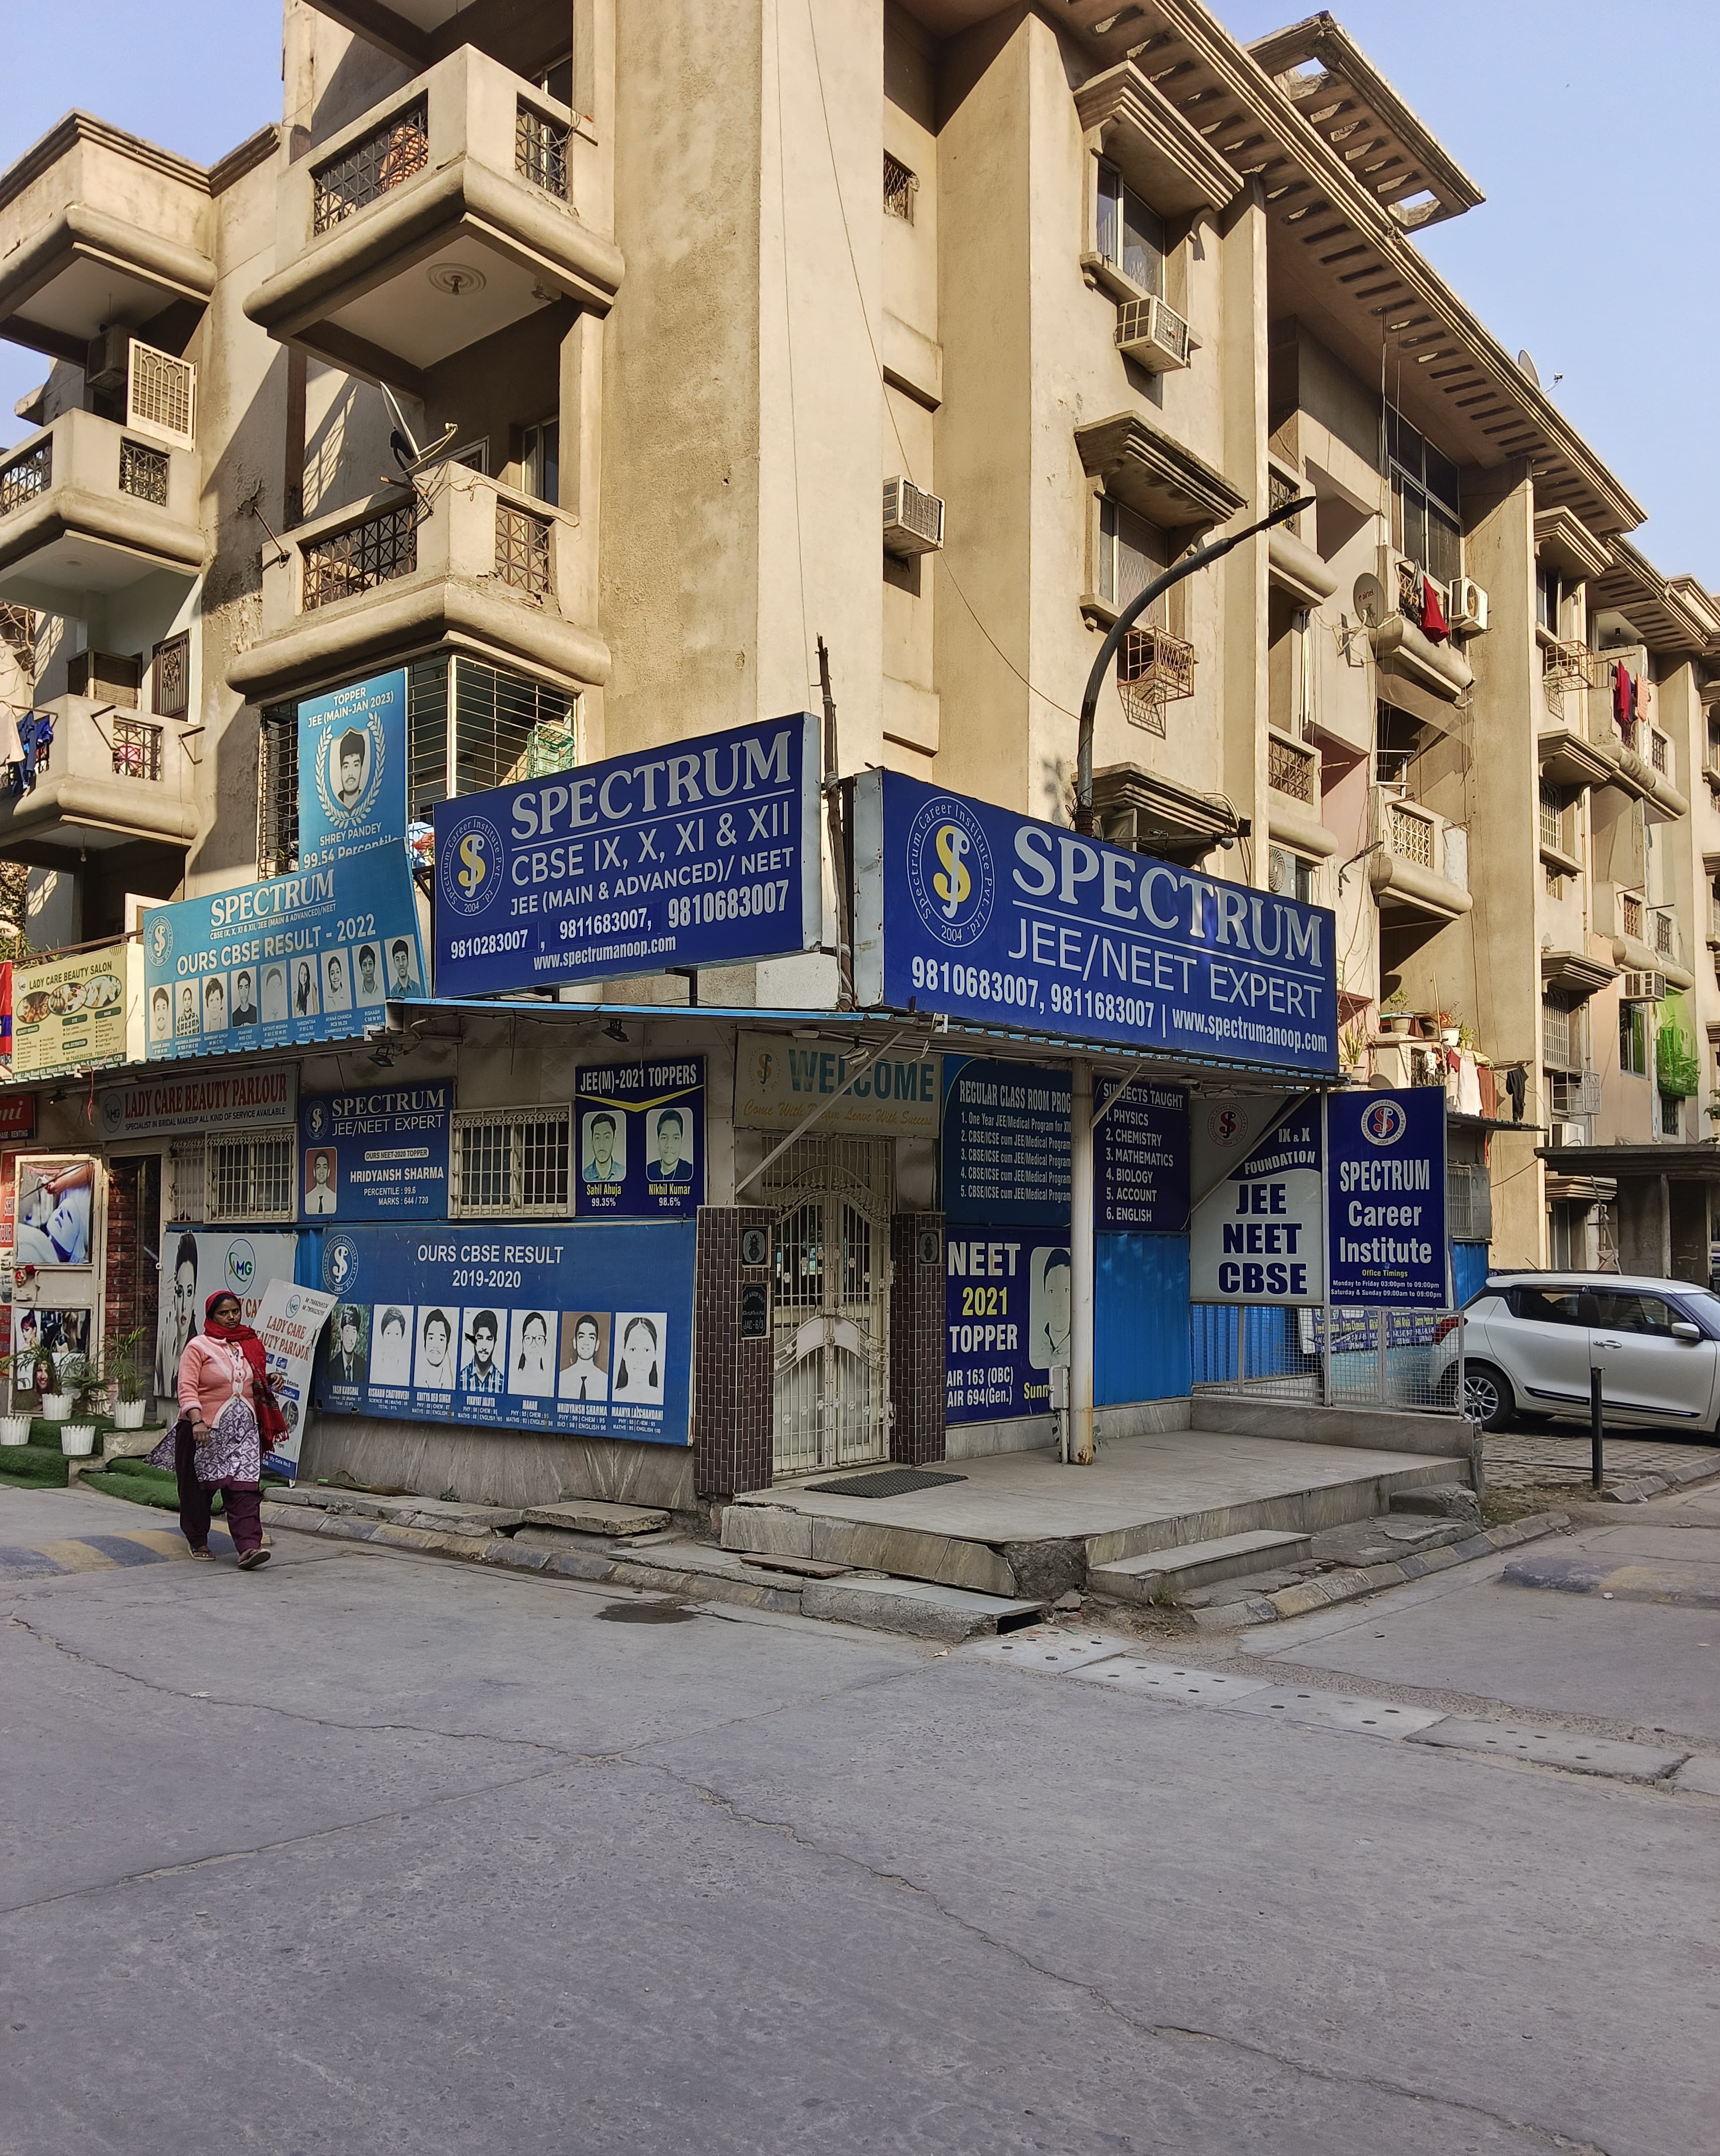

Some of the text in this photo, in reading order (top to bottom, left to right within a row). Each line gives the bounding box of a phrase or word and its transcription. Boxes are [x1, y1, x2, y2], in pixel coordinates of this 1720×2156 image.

[1363, 588, 1374, 600] airtel
[333, 687, 366, 706] TOPPER
[308, 691, 394, 728] JEE (MAIN-JAN 2023)
[511, 731, 791, 840] SPECTRUM
[320, 823, 381, 847] SHREY PANDEY
[512, 801, 788, 886] CBSE IX, X, XI & XII
[303, 851, 334, 869] 99.54
[911, 805, 992, 936] Spectrum Career Institute Pvt. Ltd.
[510, 895, 538, 916] JEE
[542, 883, 593, 913] (MAIN
[599, 882, 609, 899] &
[741, 847, 794, 875] NEET
[211, 869, 334, 927] SPECTRUM
[1012, 826, 1322, 968] SPECTRUM
[560, 907, 652, 940] 9811683007,
[668, 879, 789, 928] 9810683007
[177, 913, 376, 975] OURS CBSE RESULT 2022
[534, 936, 676, 970] www.spectrumanoop.com
[29, 961, 112, 990] LADY CARE BEAUTY SALON
[1008, 918, 1322, 1019] JEE/NEET EXPERT
[911, 957, 1327, 1054] 9810683007, 9811683007 www.spectrumanoop.com
[580, 1064, 697, 1093] JEE(M)-2021 TOPPERS
[125, 1073, 287, 1119] LADY CARE BEAUTY PARLOUR
[332, 1089, 445, 1117] SPECTRUM
[960, 1080, 1072, 1113] REGULAR CLASS ROOM PROG
[1103, 1083, 1183, 1109] SUJECTS TAUGHT
[125, 1121, 150, 1131] SPECIALIST
[177, 1117, 199, 1125] MAKEUP
[233, 1109, 255, 1118] SERVICE
[256, 1107, 286, 1117] AVAILABLE
[744, 1099, 933, 1125] Come With Leave With Success
[969, 1113, 980, 1126] One
[981, 1114, 994, 1127] Year
[995, 1115, 1029, 1129] JEE/Medical
[1031, 1120, 1053, 1133] Program
[1114, 1110, 1148, 1126] PHYSICS
[332, 1119, 392, 1138] JEE/NEET
[395, 1114, 444, 1131] EXPERT
[1279, 1127, 1310, 1143] IX & X
[961, 1130, 967, 1142] 2.
[968, 1131, 999, 1145] CBSE/ICSE
[1001, 1136, 1012, 1145] cum
[1014, 1134, 1047, 1149] JEE/Medical
[1116, 1130, 1162, 1147] CHEMISTRY
[1116, 1150, 1173, 1167] MATHEMATICS
[1245, 1150, 1315, 1175] FOUNDATION
[350, 1167, 444, 1183] HRIDYANSH SHARMA
[1116, 1169, 1153, 1184] BIOLOGY
[1340, 1160, 1429, 1192] SPECTRUM
[364, 1187, 400, 1196] PERCENTILE
[586, 1184, 603, 1196] Sahil
[669, 1183, 691, 1195] Kumar
[1117, 1188, 1157, 1202] ACCOUNT
[1236, 1183, 1287, 1215] JEE
[591, 1197, 616, 1207] 99.35%
[658, 1196, 681, 1207] 98.6%
[1116, 1208, 1152, 1222] ENGLISH
[1349, 1201, 1421, 1227] Career
[1223, 1223, 1302, 1254] NEET
[1340, 1237, 1432, 1264] Institute
[418, 1245, 563, 1265] OURS CBSE RESULT
[948, 1242, 1021, 1276] NEET
[452, 1270, 521, 1289] 2019-2020
[1218, 1262, 1307, 1295] CBSE
[1333, 1280, 1354, 1288] Monday
[1362, 1269, 1408, 1278] Office Timings
[962, 1287, 1007, 1316] 2021
[1331, 1288, 1355, 1296] Saturday
[1362, 1289, 1382, 1297] Sunday
[266, 1315, 307, 1339] LADY CARE
[949, 1324, 1018, 1353] TOPPER
[946, 1367, 1014, 1387] AIR 163 (OBC)
[947, 1387, 1012, 1408] AIR 694(Gen.)
[586, 1405, 607, 1416] SHARMA
